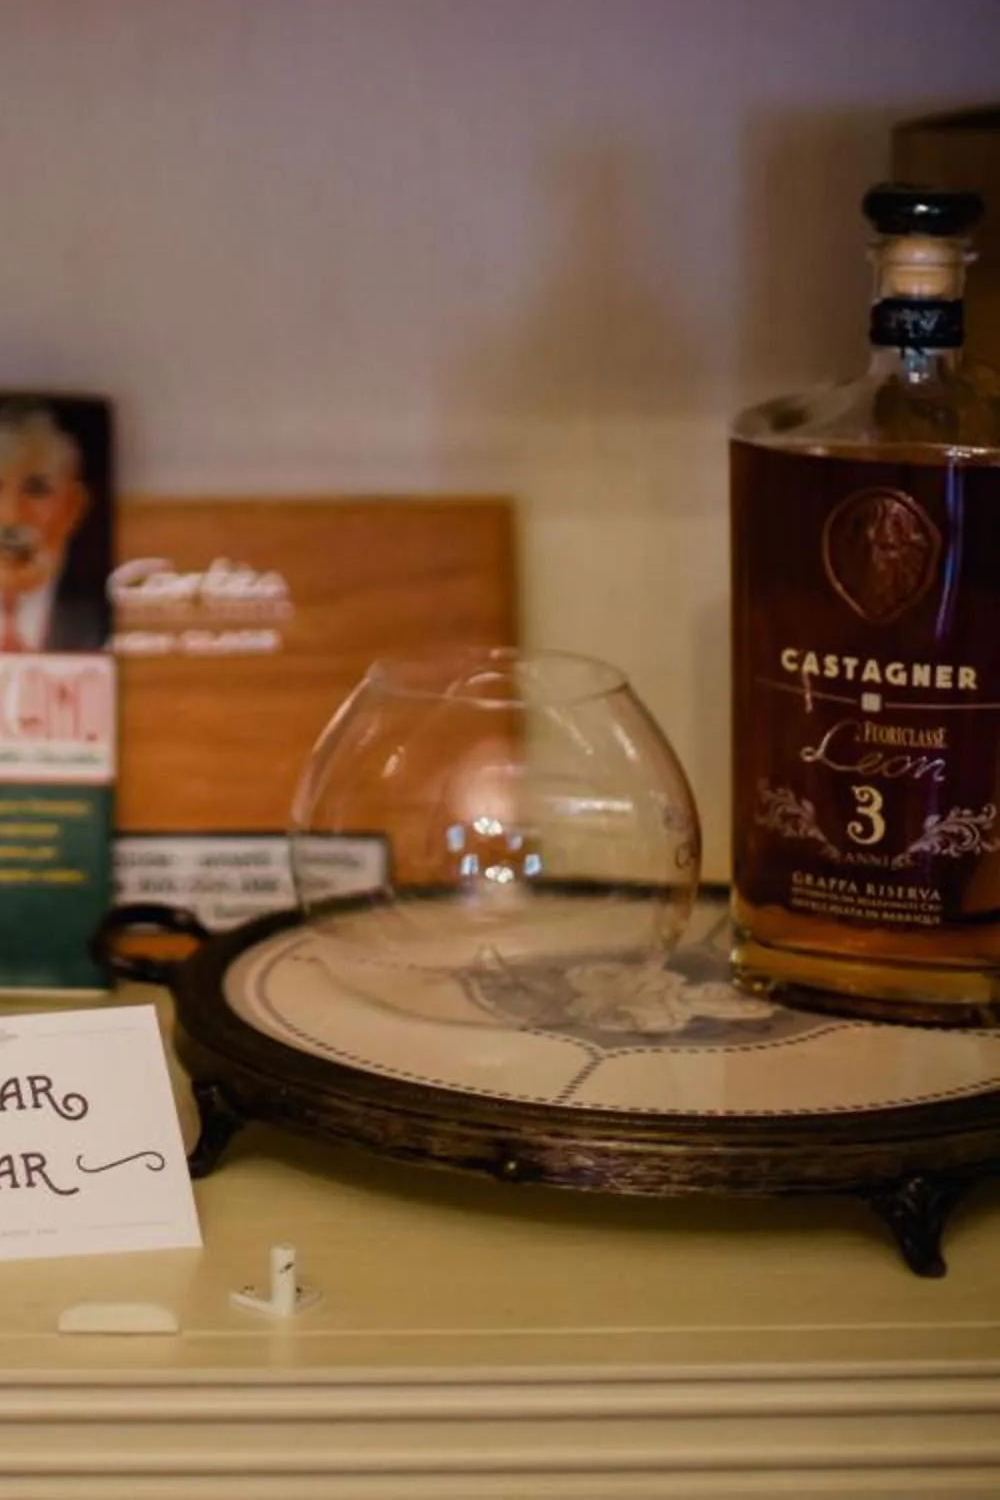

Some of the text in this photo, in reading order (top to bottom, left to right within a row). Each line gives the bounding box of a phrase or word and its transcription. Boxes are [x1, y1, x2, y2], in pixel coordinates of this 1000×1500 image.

[781, 648, 978, 690] CASTAGNER
[801, 718, 947, 782] Leon
[847, 785, 886, 846] 3
[791, 870, 858, 893] GRAPPA
[866, 882, 942, 901] RISERVA
